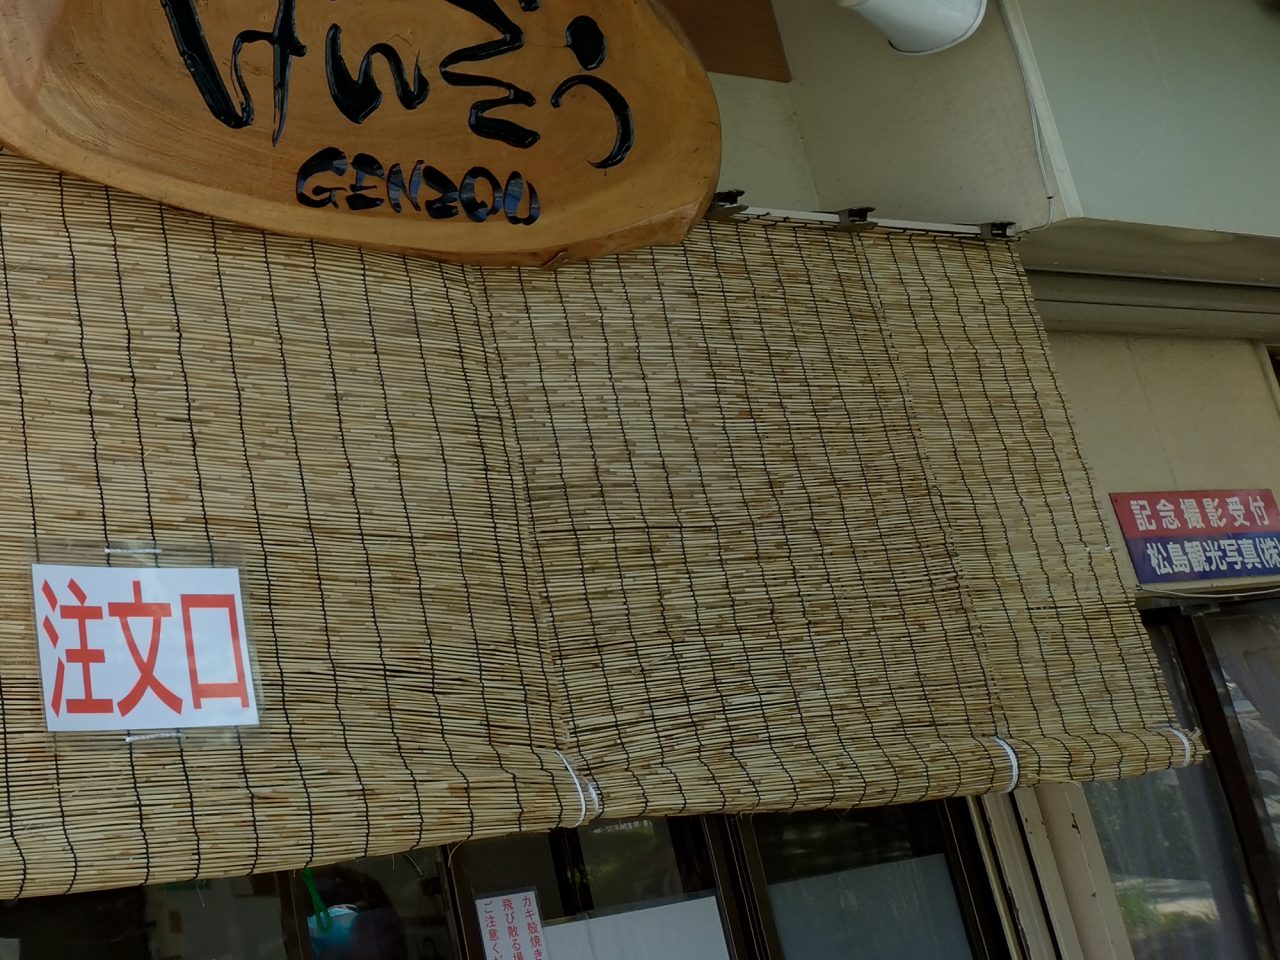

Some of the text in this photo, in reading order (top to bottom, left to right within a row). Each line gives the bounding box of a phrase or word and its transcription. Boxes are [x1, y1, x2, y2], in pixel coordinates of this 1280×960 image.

[1129, 495, 1270, 531] 記念撮影受付
[41, 578, 250, 718] 注文口
